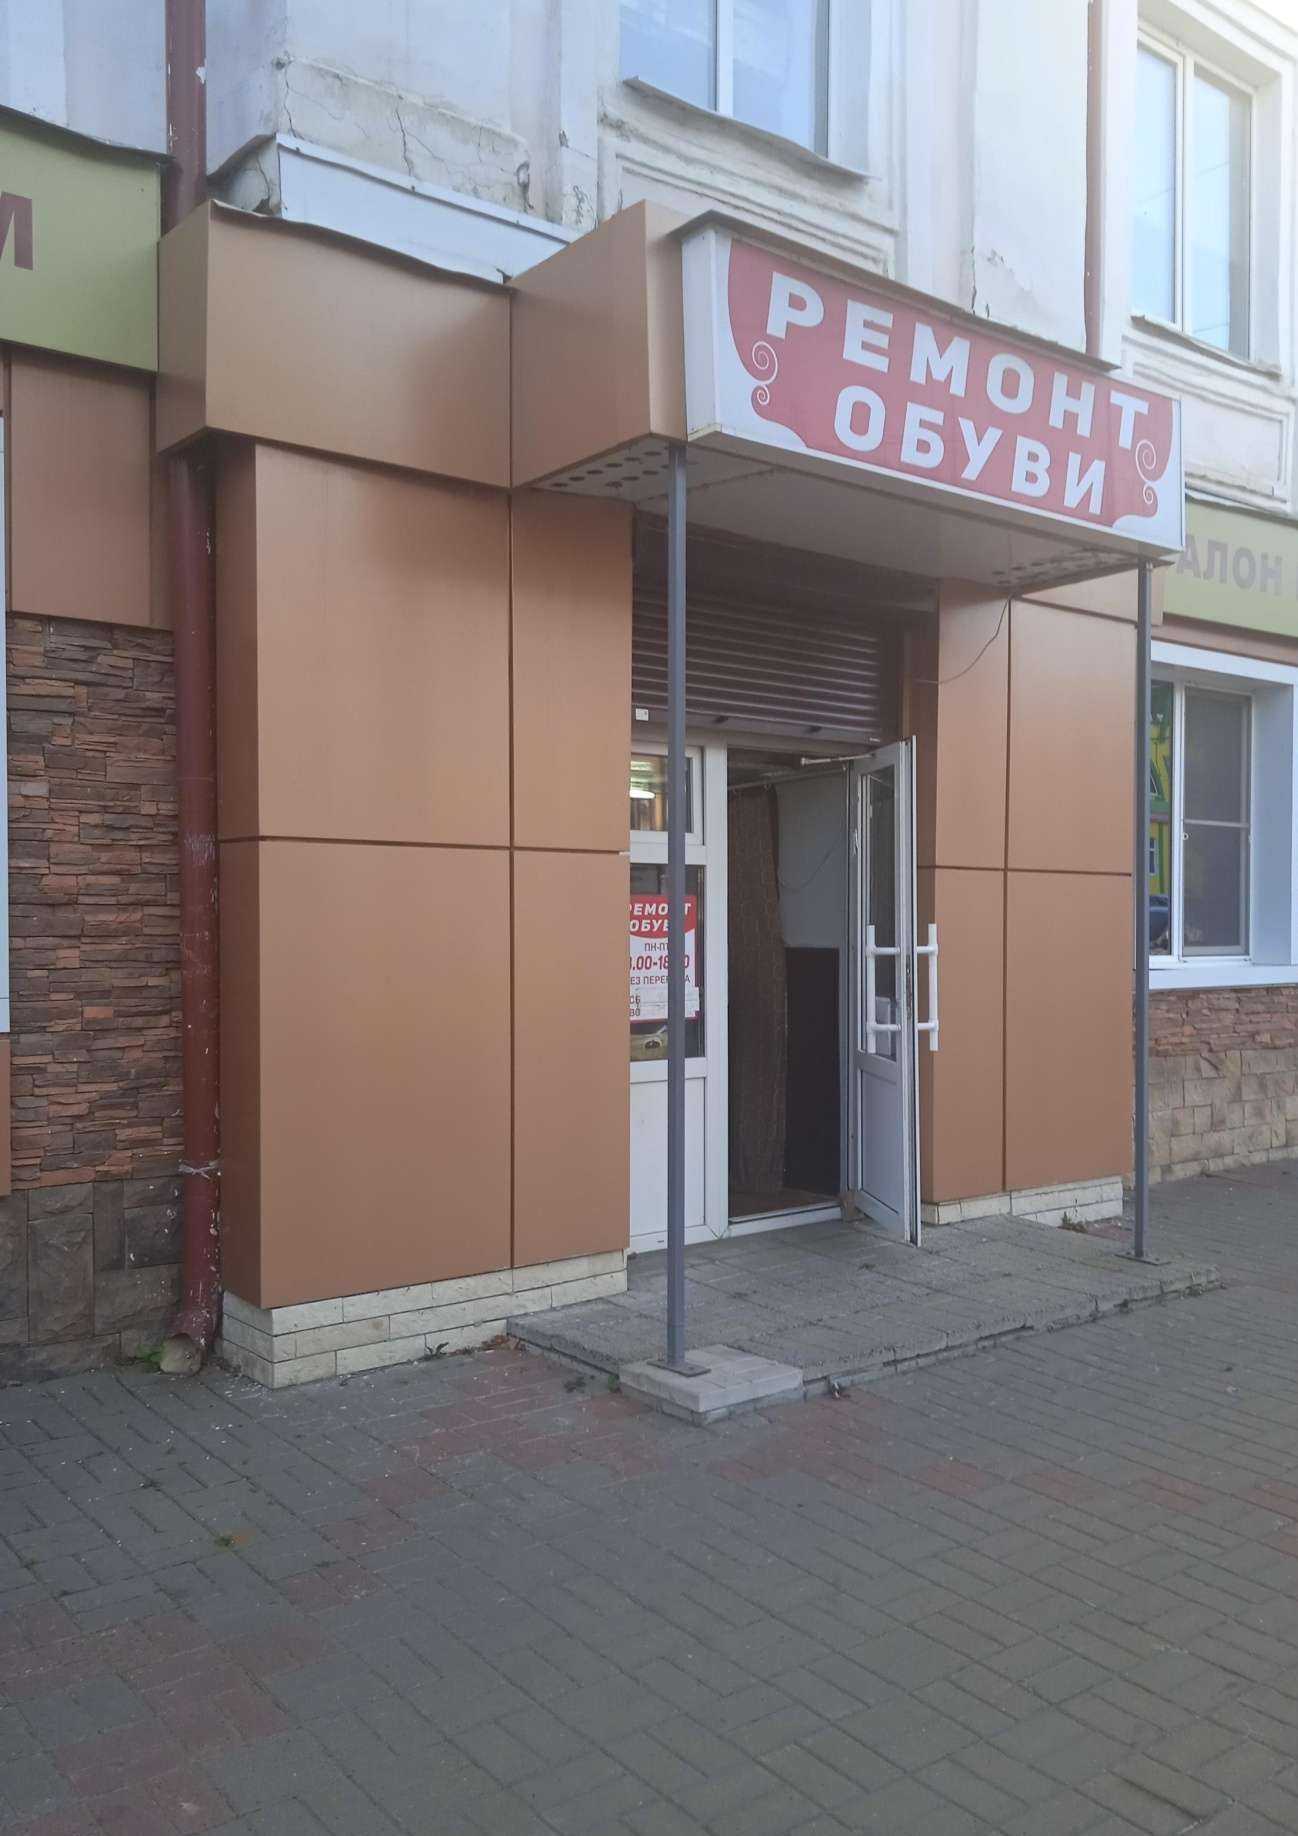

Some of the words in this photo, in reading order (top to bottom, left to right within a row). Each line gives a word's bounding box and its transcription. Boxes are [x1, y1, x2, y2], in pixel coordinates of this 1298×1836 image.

[766, 271, 1149, 451] РЕМОНТ
[833, 385, 1106, 515] ОБУВИ
[1175, 533, 1284, 597] АЛОН
[629, 902, 692, 916] ЕМОТ
[629, 918, 669, 932] ОБУ
